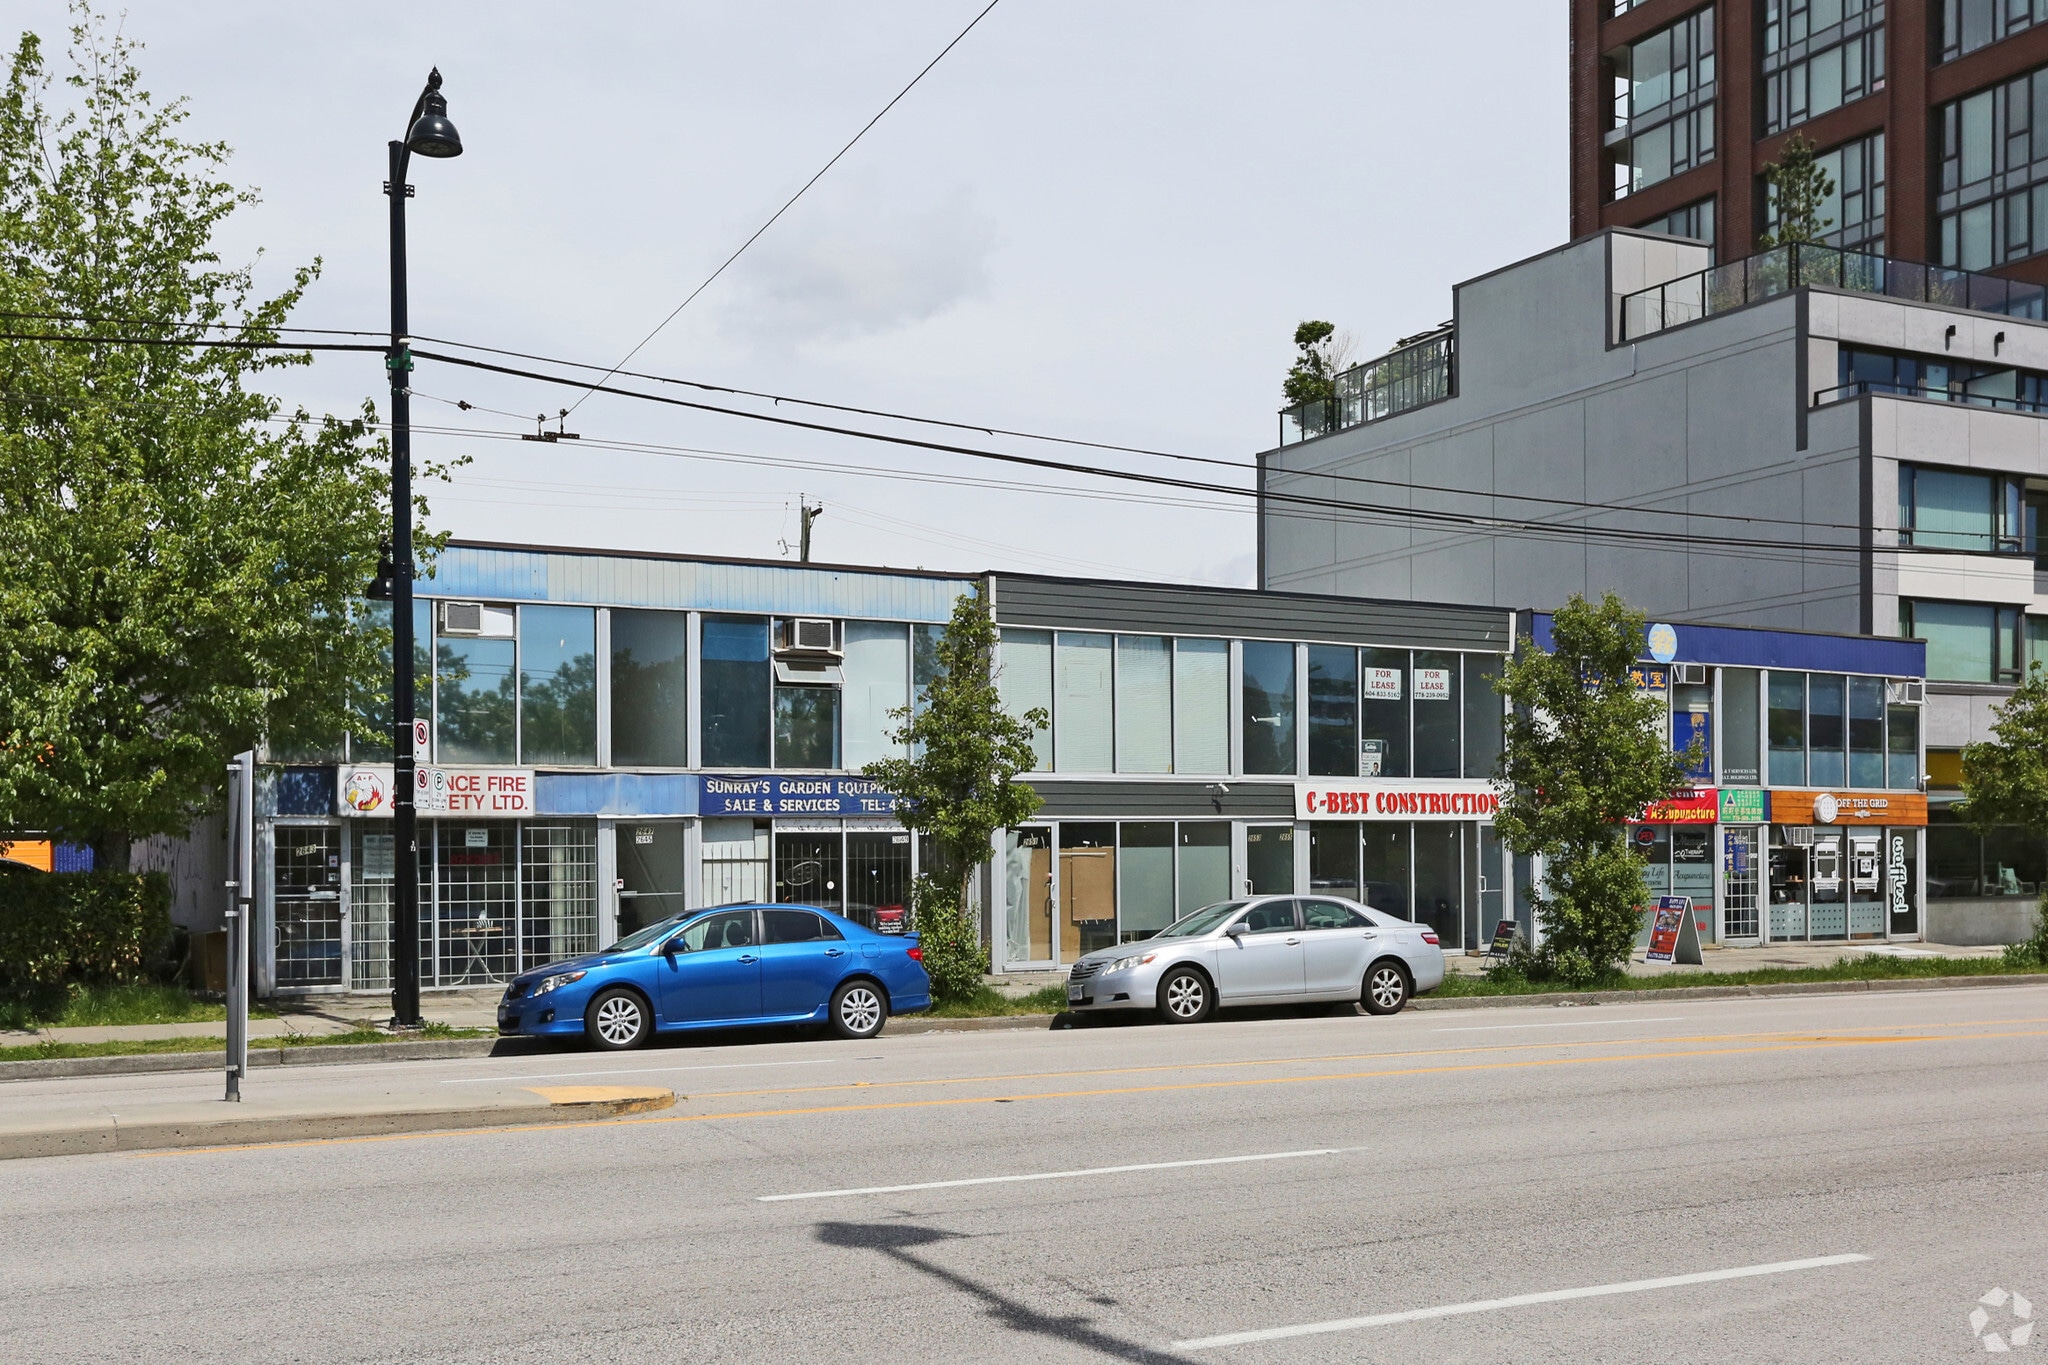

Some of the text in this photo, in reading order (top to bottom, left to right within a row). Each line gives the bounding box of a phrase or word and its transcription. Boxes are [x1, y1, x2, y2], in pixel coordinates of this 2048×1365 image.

[1375, 669, 1392, 678] FOR
[1424, 671, 1440, 679] FOR
[1371, 681, 1396, 690] LEASE
[1420, 682, 1445, 690] LEASE
[446, 776, 526, 792] NCE FIRE
[706, 780, 902, 797] SUNRAY'S GARDEN EQUIPM
[448, 794, 485, 810] ETY
[492, 795, 528, 810] LTD.
[725, 798, 756, 812] SALE
[763, 799, 774, 812] &
[780, 799, 840, 812] SERVICES
[860, 798, 886, 811] TEL:
[1376, 792, 1501, 815] CONSTRUCTION
[1836, 798, 1888, 808] OFF THE GRID
[1638, 832, 1656, 840] OPEN
[1652, 866, 1665, 878] Life
[1673, 870, 1710, 882] Acupuncture
[1889, 836, 1909, 913] waffles!
